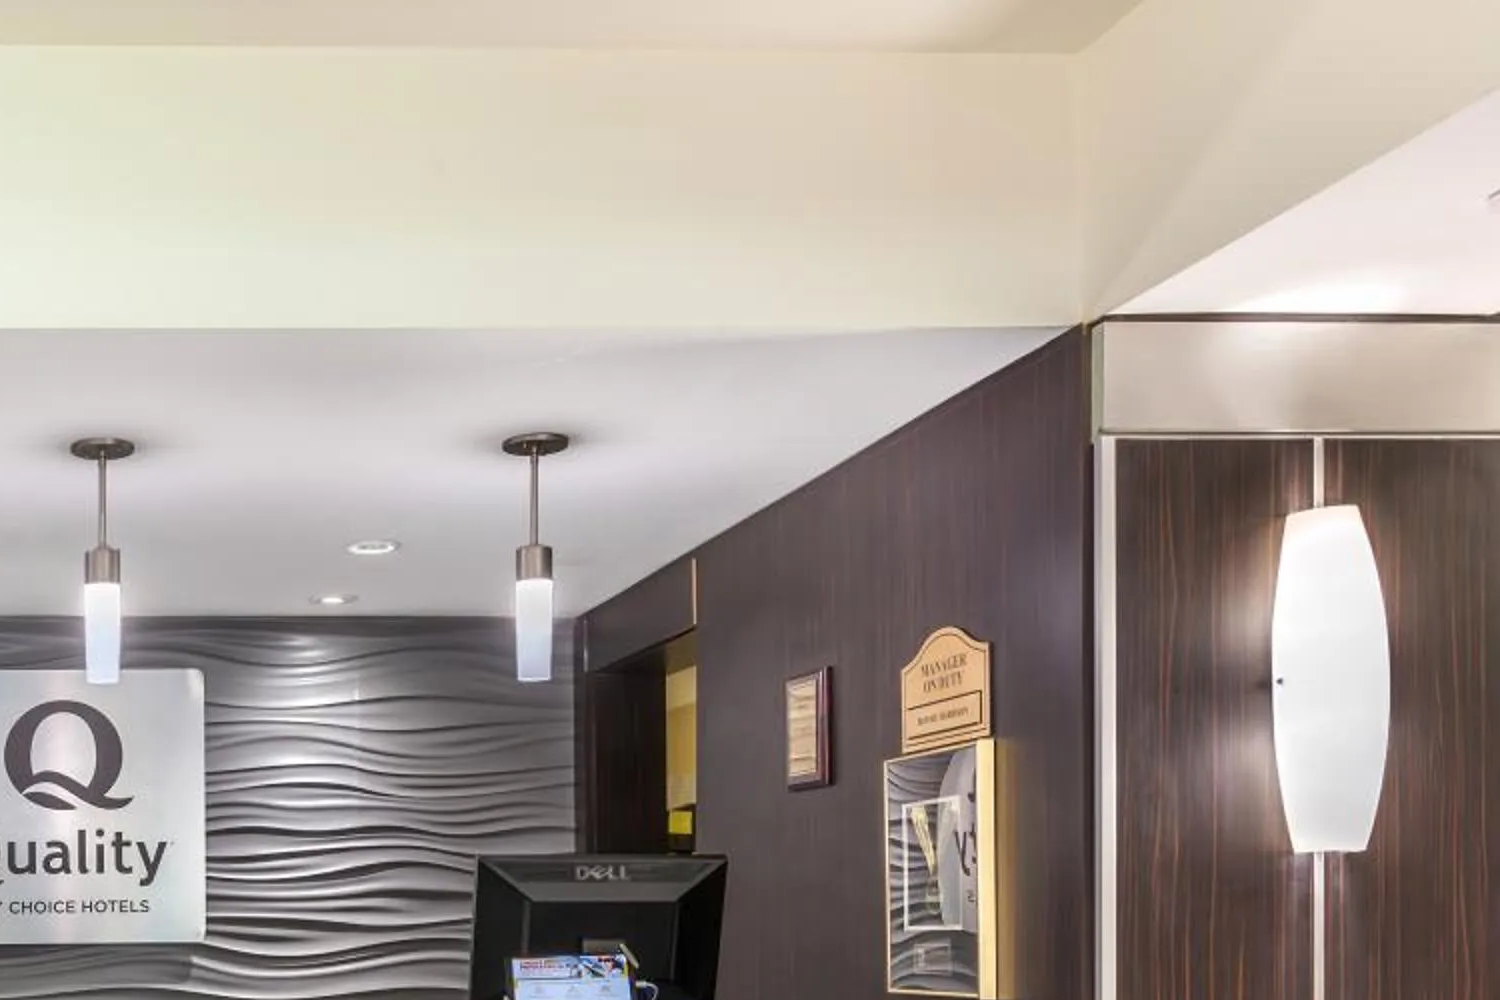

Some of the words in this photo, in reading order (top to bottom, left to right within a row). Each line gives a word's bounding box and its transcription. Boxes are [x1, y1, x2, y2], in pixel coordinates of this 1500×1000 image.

[576, 864, 630, 881] DELL
[9, 900, 75, 915] CHOICE
[81, 899, 150, 914] HOTELS
